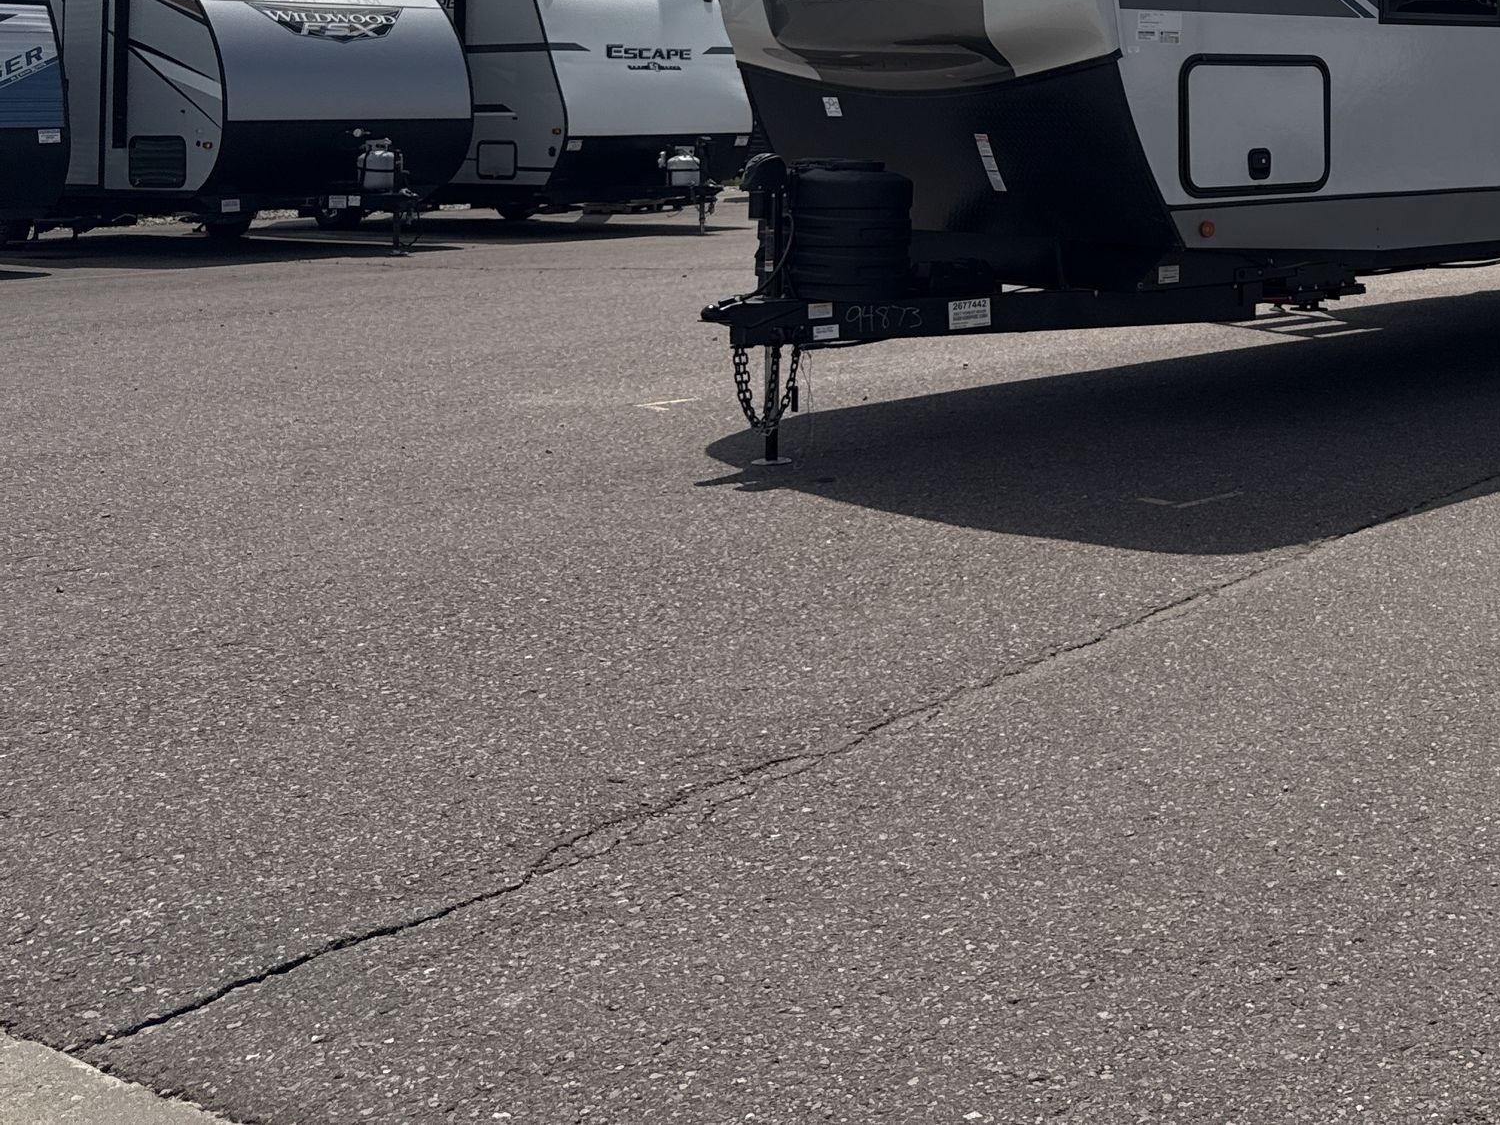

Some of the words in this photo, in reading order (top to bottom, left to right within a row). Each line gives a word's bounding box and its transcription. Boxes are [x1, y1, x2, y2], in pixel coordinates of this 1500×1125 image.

[262, 10, 397, 25] WILDWOOD
[300, 22, 382, 37] FSX
[606, 44, 692, 60] ESCAPE
[0, 46, 43, 78] ER
[845, 305, 923, 332] 94873
